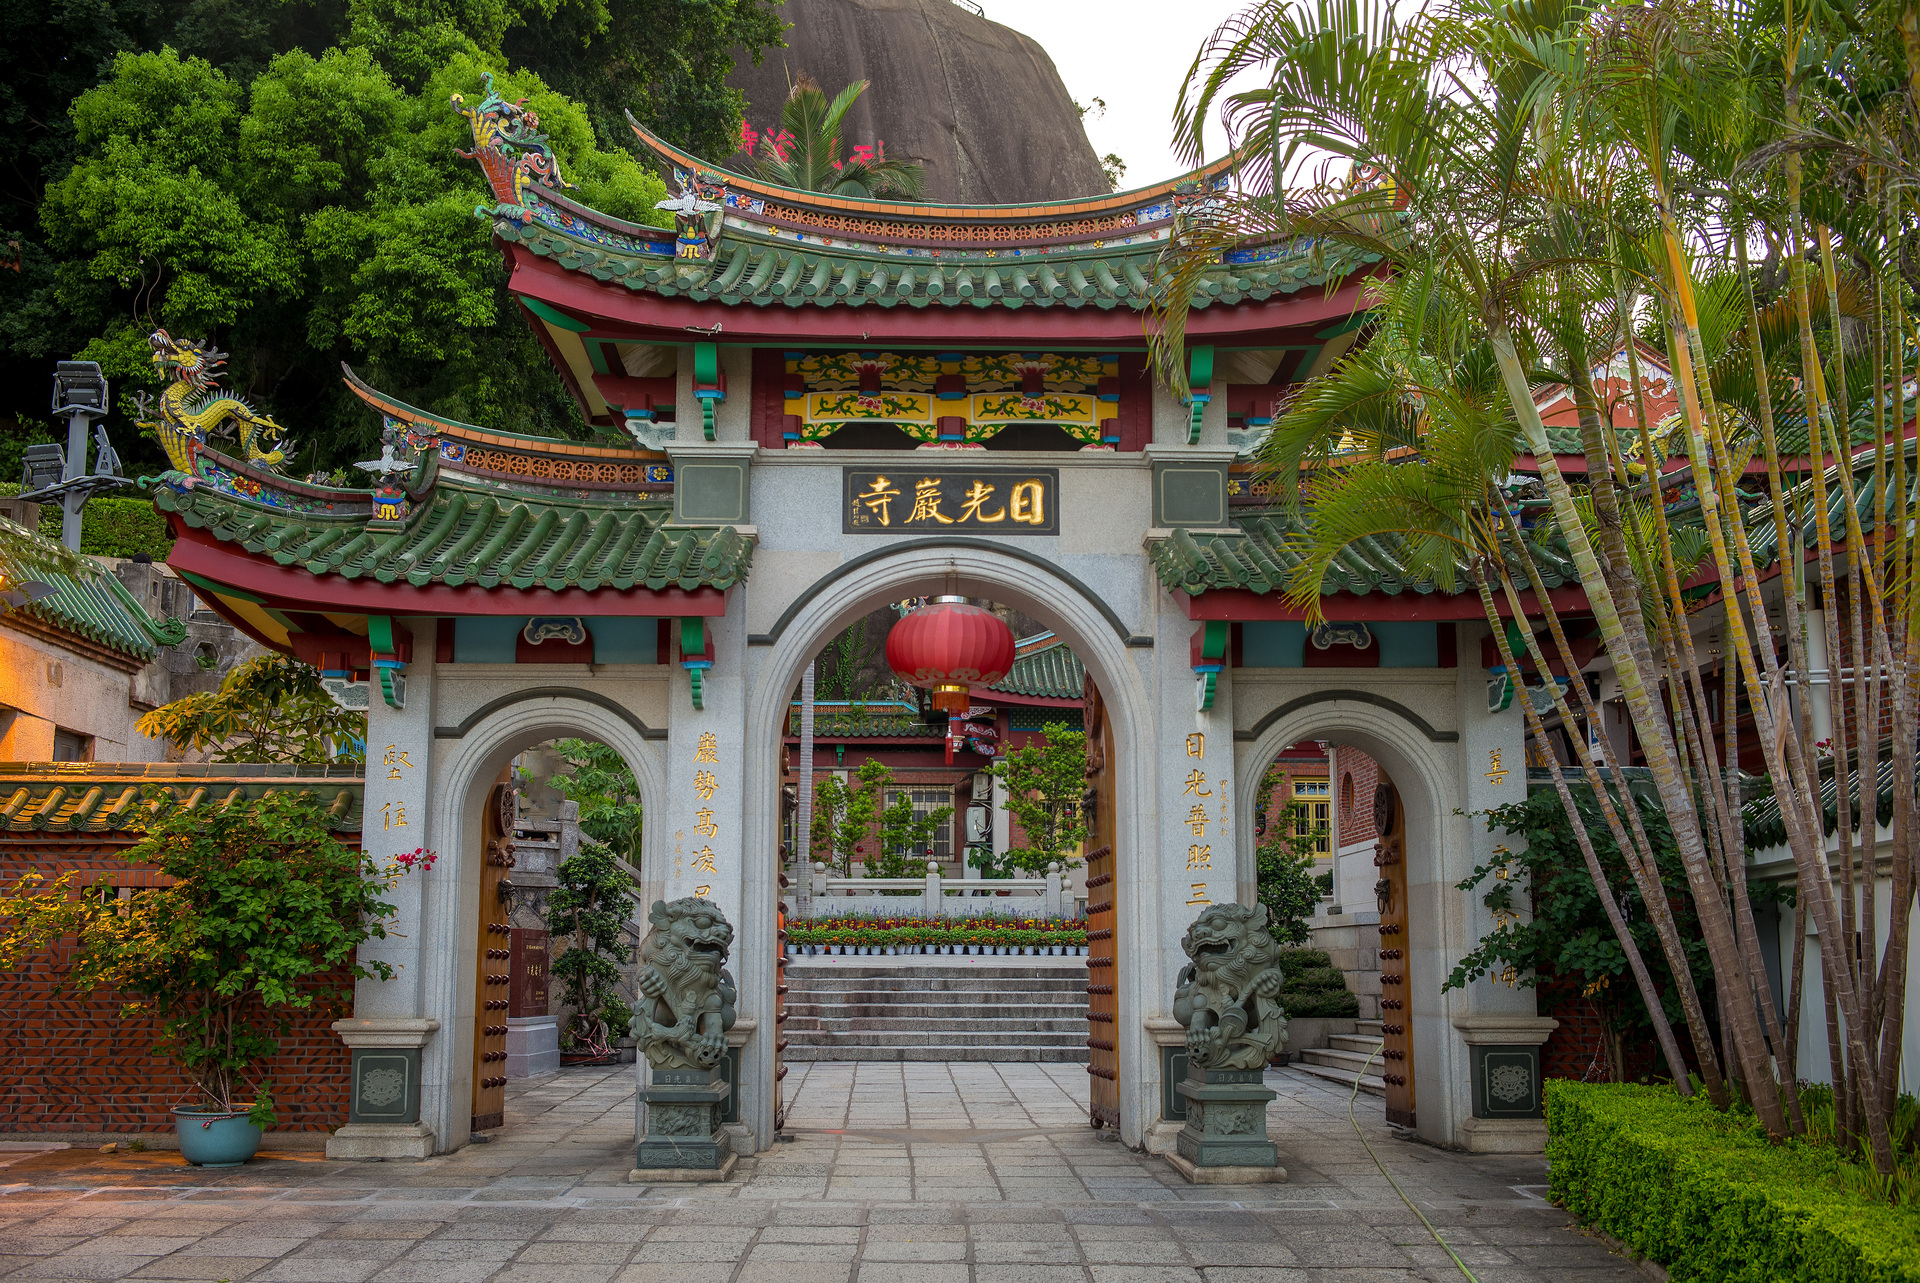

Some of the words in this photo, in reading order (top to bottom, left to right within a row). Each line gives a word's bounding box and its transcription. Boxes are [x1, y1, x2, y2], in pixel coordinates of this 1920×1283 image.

[1182, 732, 1212, 906] 日光普照三
